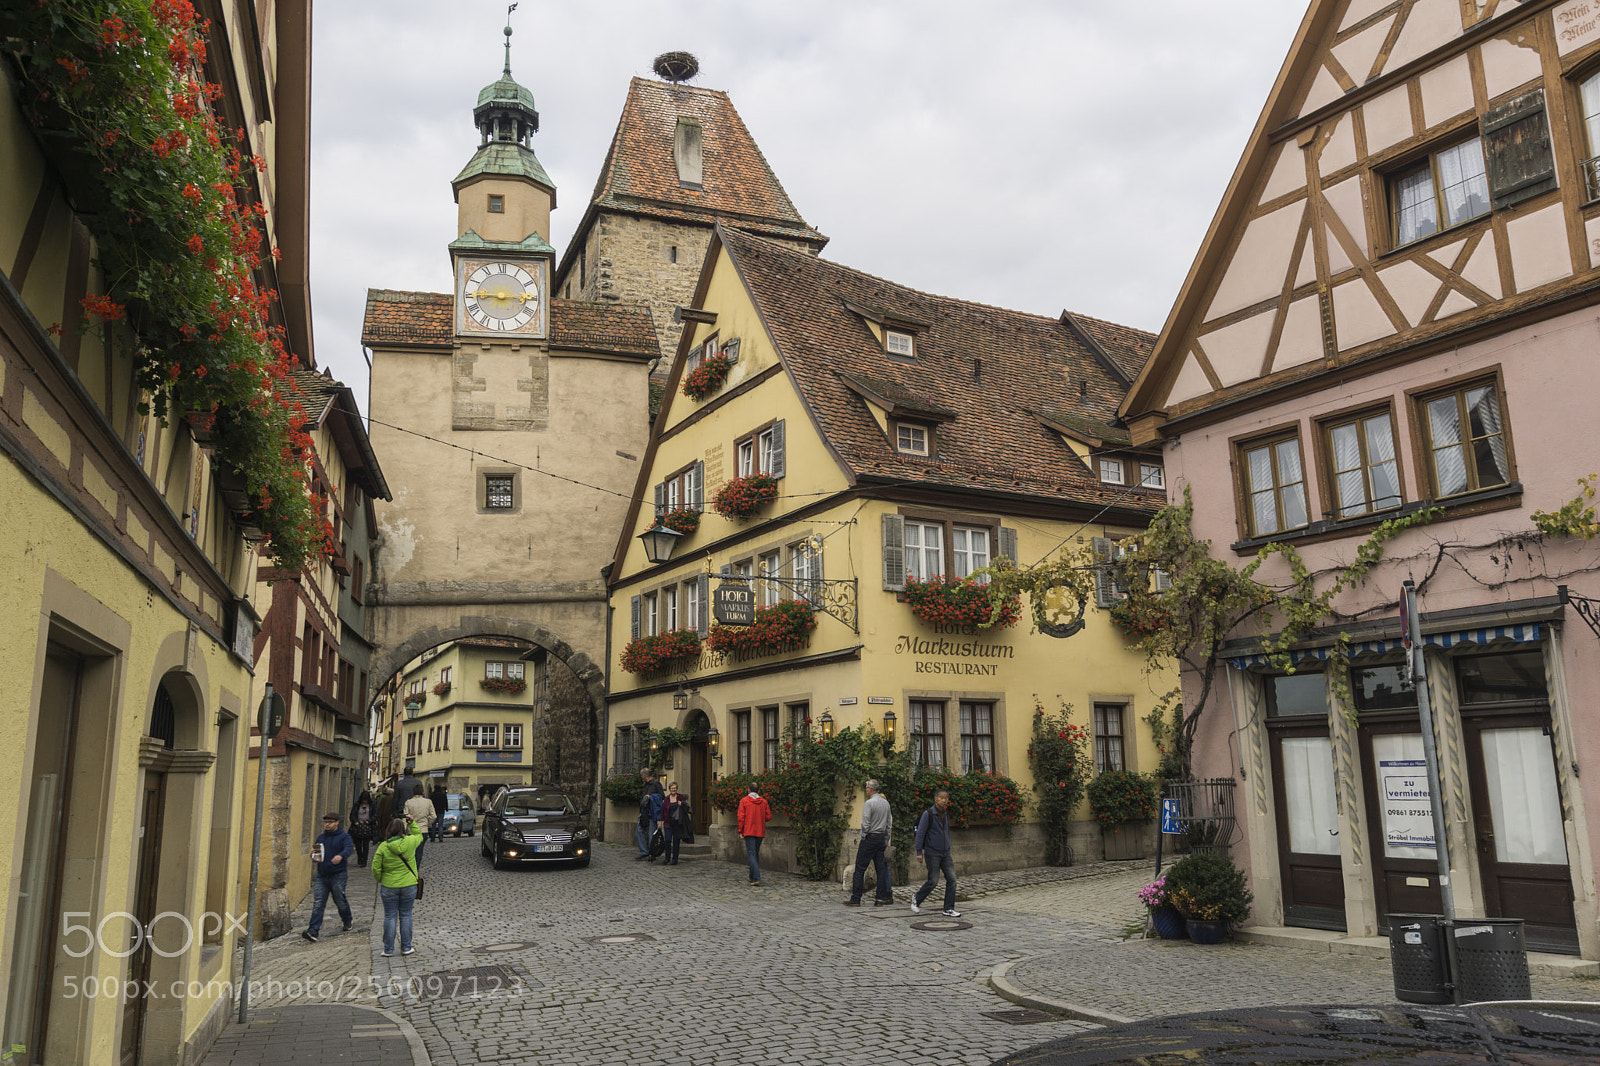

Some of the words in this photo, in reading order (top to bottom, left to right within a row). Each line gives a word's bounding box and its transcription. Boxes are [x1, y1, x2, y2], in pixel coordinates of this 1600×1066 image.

[726, 612, 747, 620] TURM
[895, 635, 1015, 658] Markusturm
[915, 661, 998, 676] RESTAURANT
